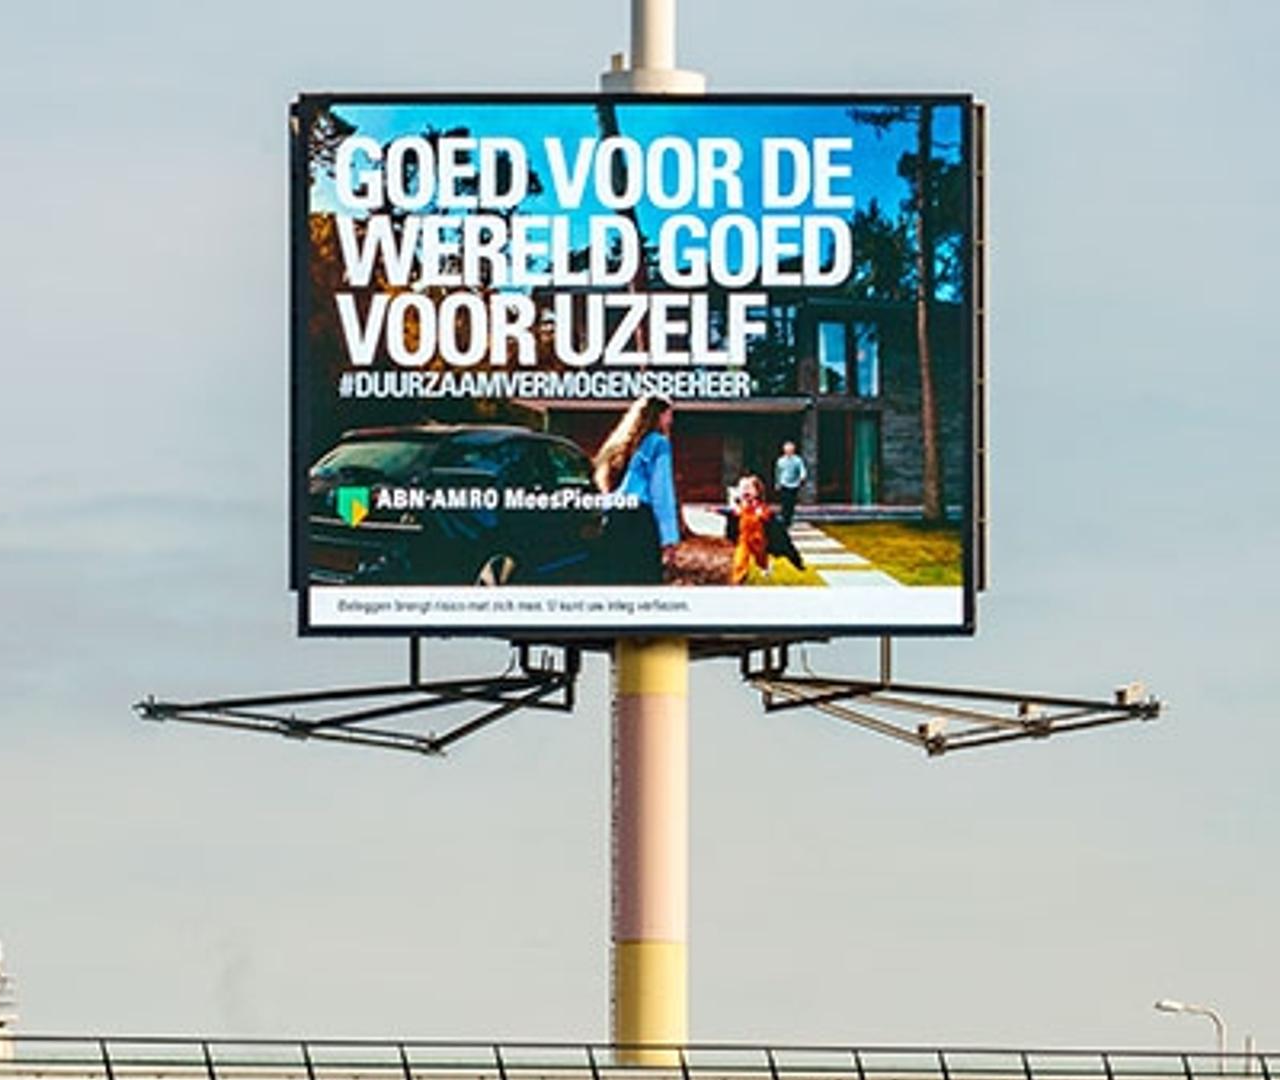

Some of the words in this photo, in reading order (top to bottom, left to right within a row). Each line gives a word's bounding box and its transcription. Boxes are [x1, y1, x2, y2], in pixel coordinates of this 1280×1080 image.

[334, 136, 526, 209] GOED
[545, 137, 745, 209] VOOR
[762, 137, 853, 208] DE
[338, 214, 638, 287] WERELD
[658, 214, 853, 287] GOED
[337, 292, 537, 366] VOOR
[553, 292, 767, 366] UZELF
[339, 370, 751, 397] #DUURZAAMVERMOGENSBEHEER
[504, 485, 639, 510] MeesPierson
